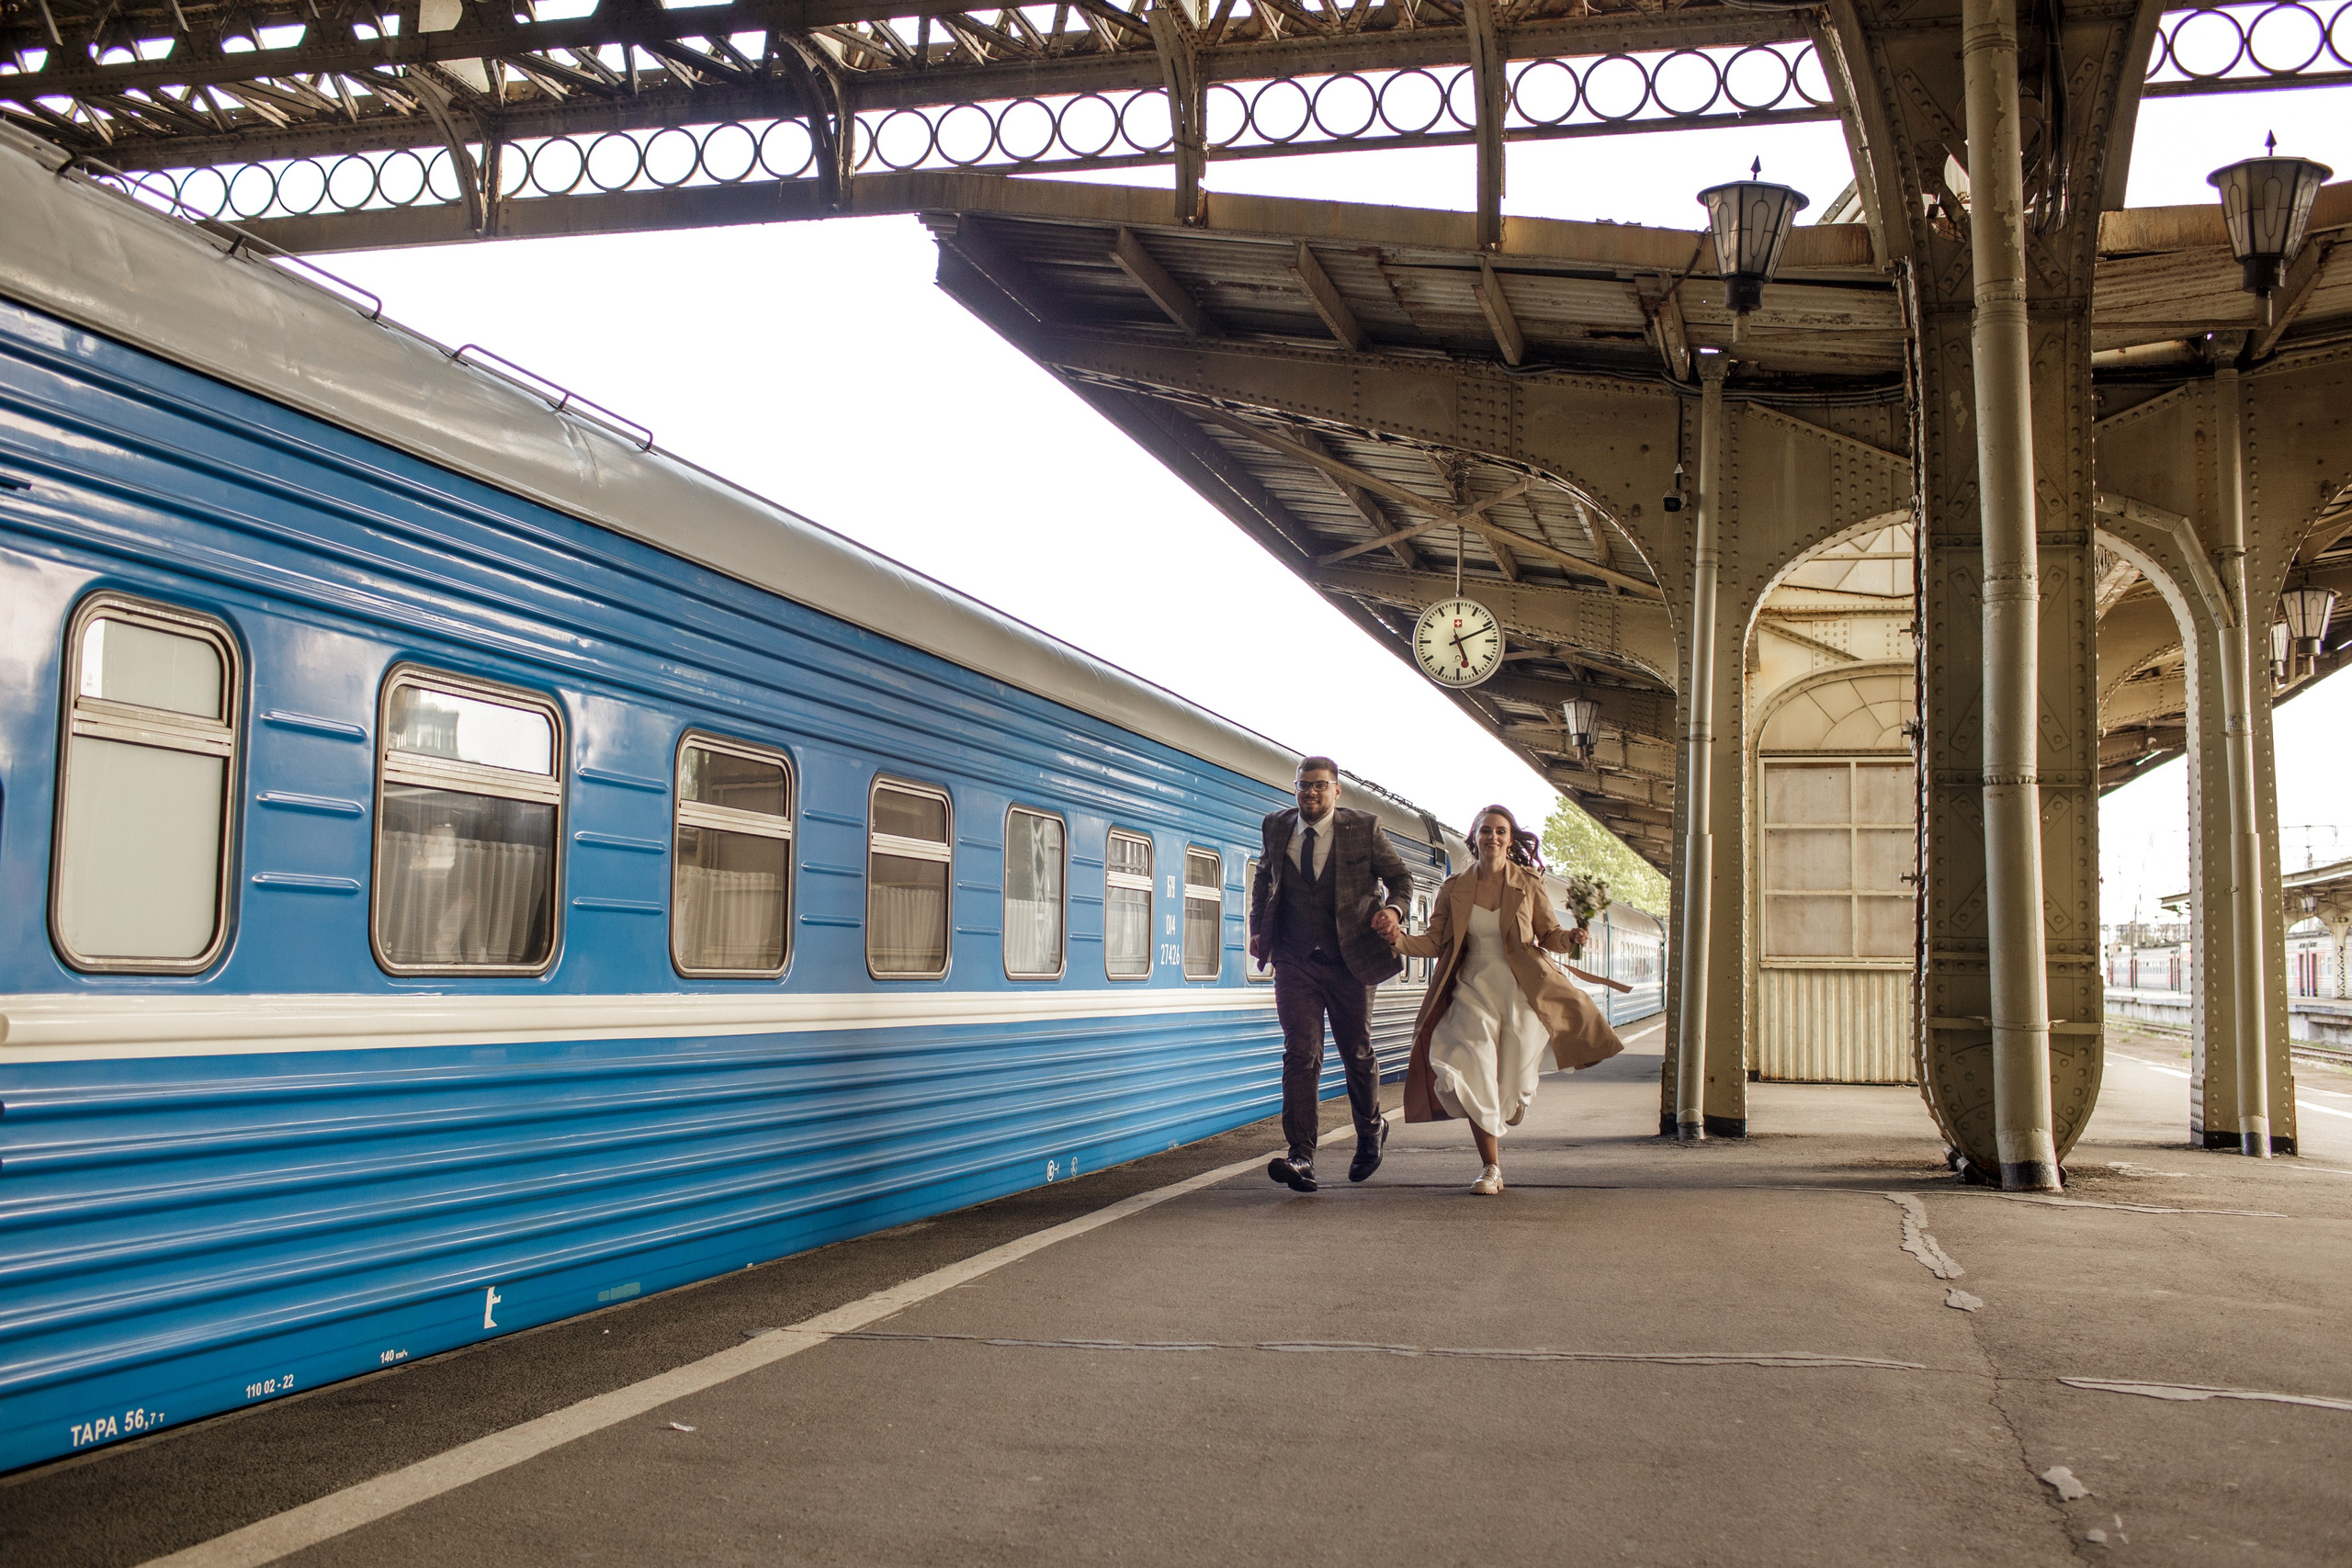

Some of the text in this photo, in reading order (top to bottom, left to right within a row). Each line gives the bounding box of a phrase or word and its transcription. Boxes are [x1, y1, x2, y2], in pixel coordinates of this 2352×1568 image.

[1166, 874, 1176, 898] БЧ
[1160, 943, 1181, 965] 27426
[380, 1349, 394, 1364] 140
[245, 1382, 262, 1399] 110
[264, 1378, 276, 1394] 02
[282, 1373, 294, 1390] 22
[71, 1416, 118, 1447] ТАРА
